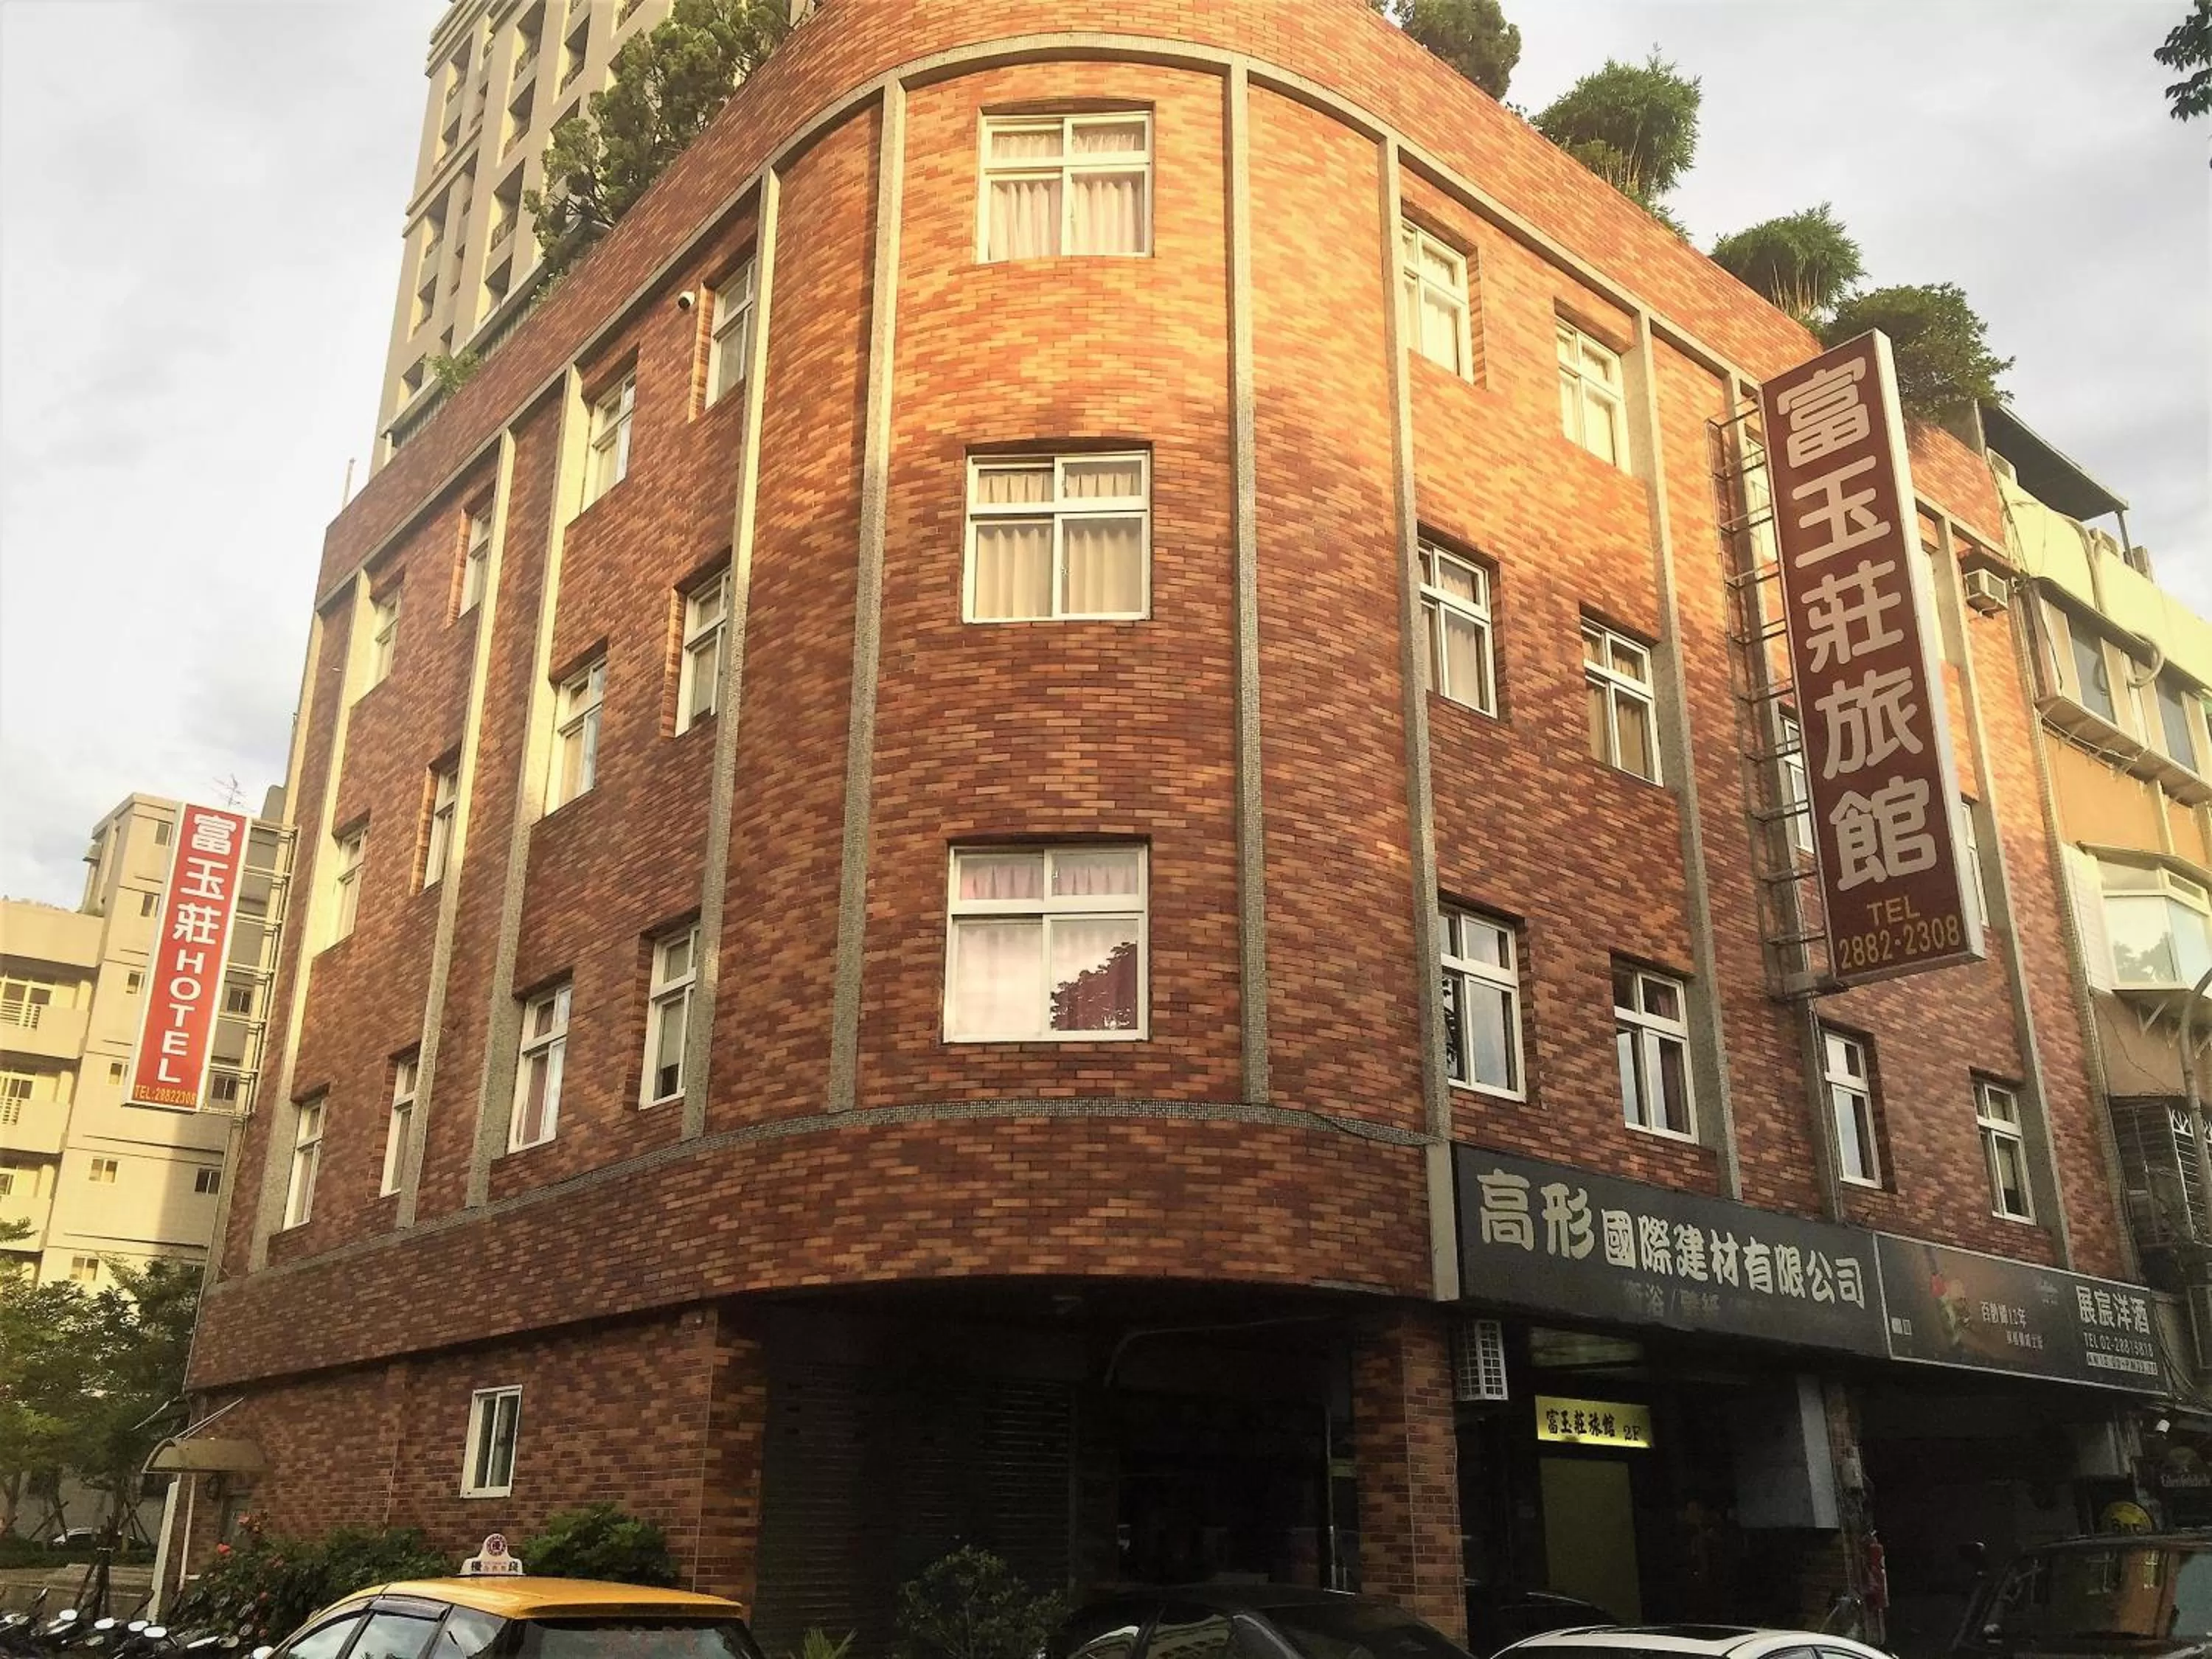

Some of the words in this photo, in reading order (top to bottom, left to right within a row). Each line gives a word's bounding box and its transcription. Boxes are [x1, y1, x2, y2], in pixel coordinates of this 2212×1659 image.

[1777, 356, 1937, 892] 富玉莊旅館
[173, 813, 237, 946] 富玉莊
[1866, 895, 1921, 926] TEL
[156, 950, 202, 1083] HOTEL
[1623, 1425, 1641, 1441] 2F
